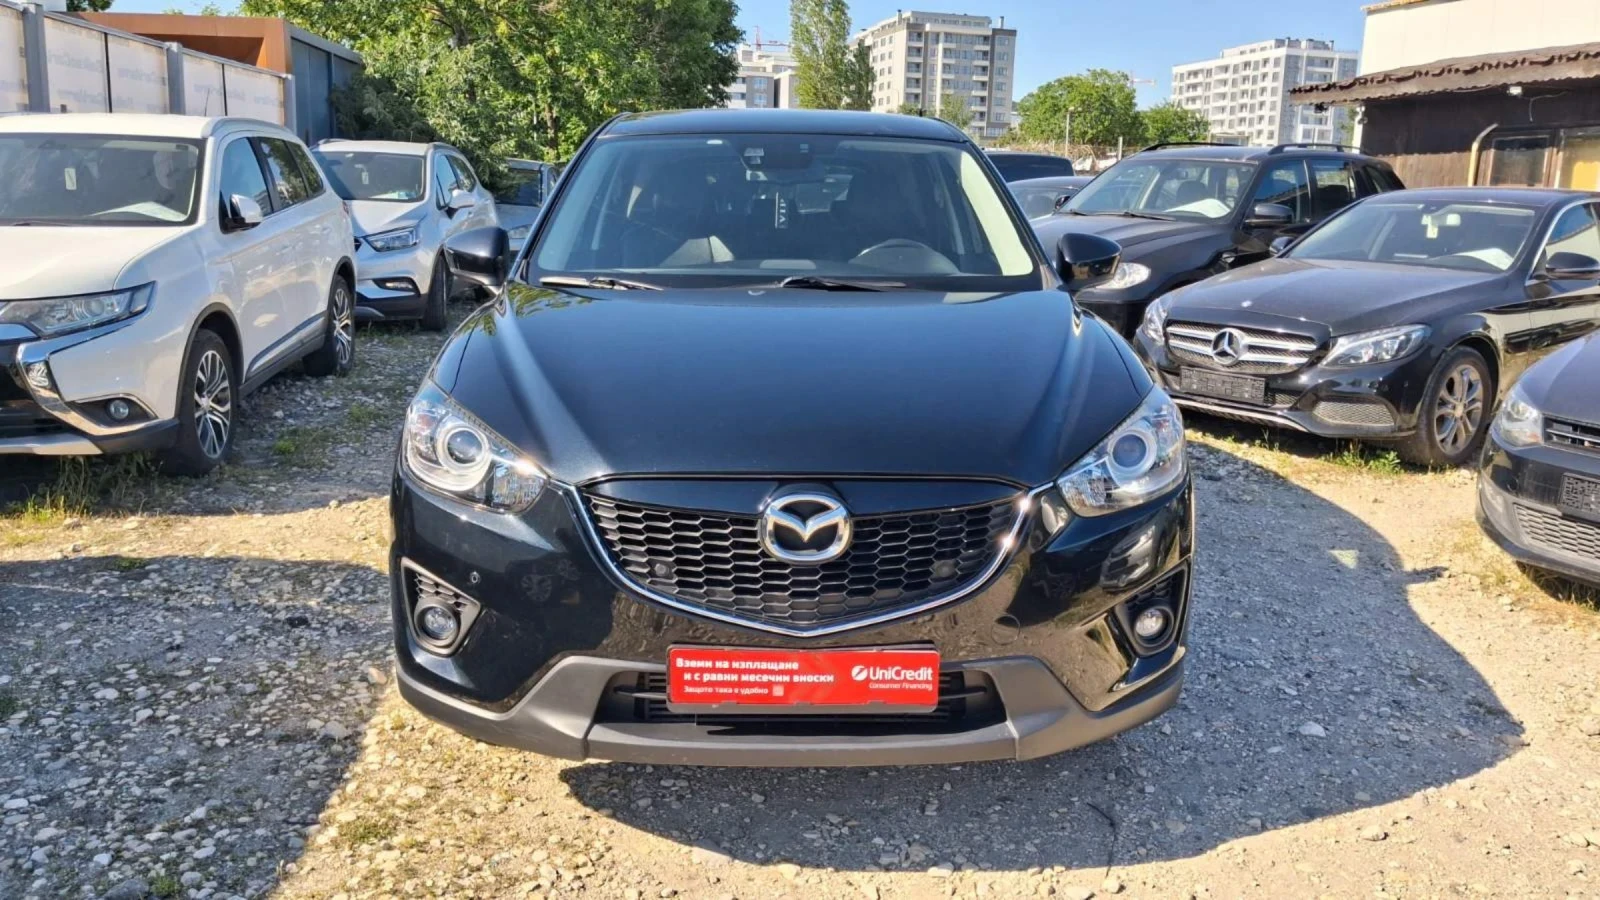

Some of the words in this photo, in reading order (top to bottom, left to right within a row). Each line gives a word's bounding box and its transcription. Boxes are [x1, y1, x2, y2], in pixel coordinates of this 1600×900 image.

[676, 658, 713, 668] Вземи
[715, 660, 729, 669] на
[732, 660, 799, 672] изплащане
[684, 672, 691, 681] и
[694, 673, 700, 681] с
[703, 673, 738, 683] равни
[741, 674, 790, 682] месечни
[793, 675, 834, 683] вноски
[869, 666, 933, 681] UniCredit
[684, 686, 713, 694] Защото
[740, 687, 768, 695] удобно
[902, 682, 933, 691] Financing
